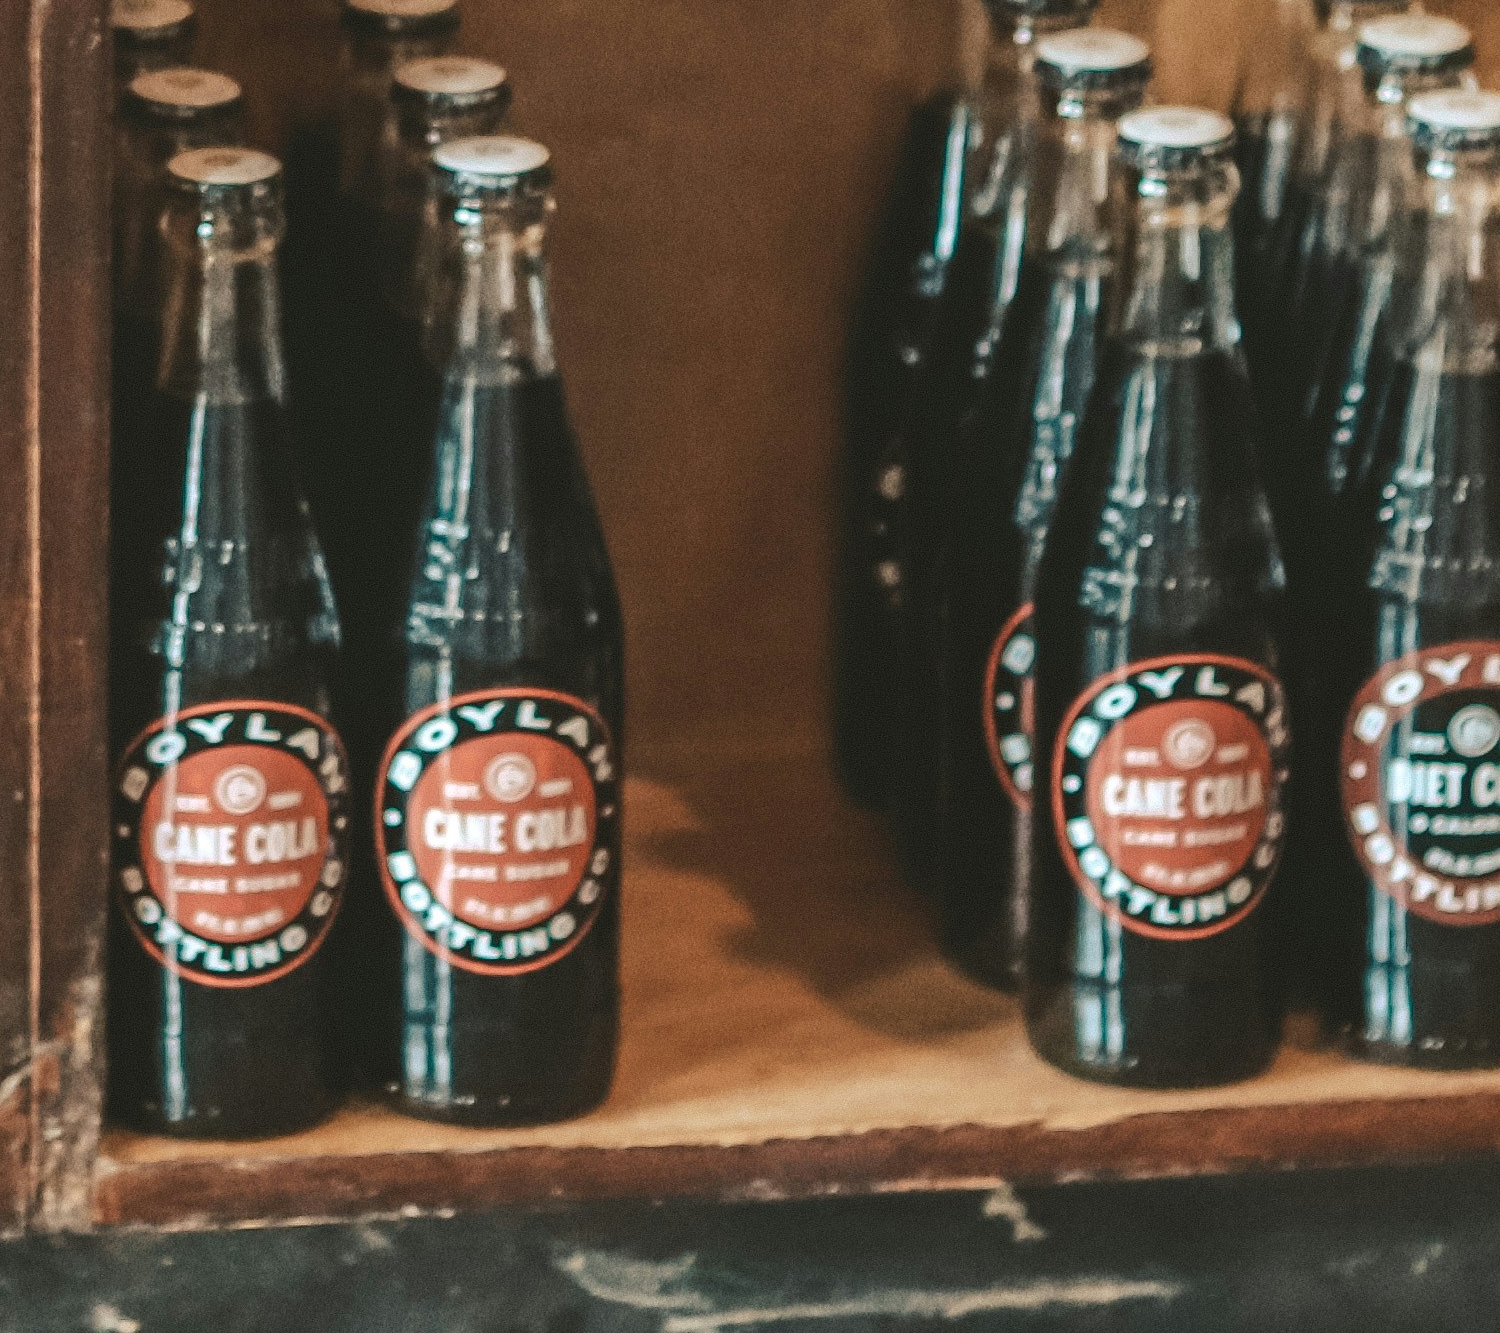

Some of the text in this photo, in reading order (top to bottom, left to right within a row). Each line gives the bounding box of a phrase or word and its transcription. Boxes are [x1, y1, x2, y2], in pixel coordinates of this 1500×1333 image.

[387, 699, 614, 792] BOYLAN
[1066, 664, 1288, 757] BOYLAN
[120, 711, 347, 803] BOYLAN
[1386, 759, 1464, 808] DIET
[1102, 768, 1265, 819] CANE COLA
[154, 816, 320, 866] CANE COLA
[423, 805, 588, 854] CANE COLA
[387, 850, 577, 961] BOTTLING
